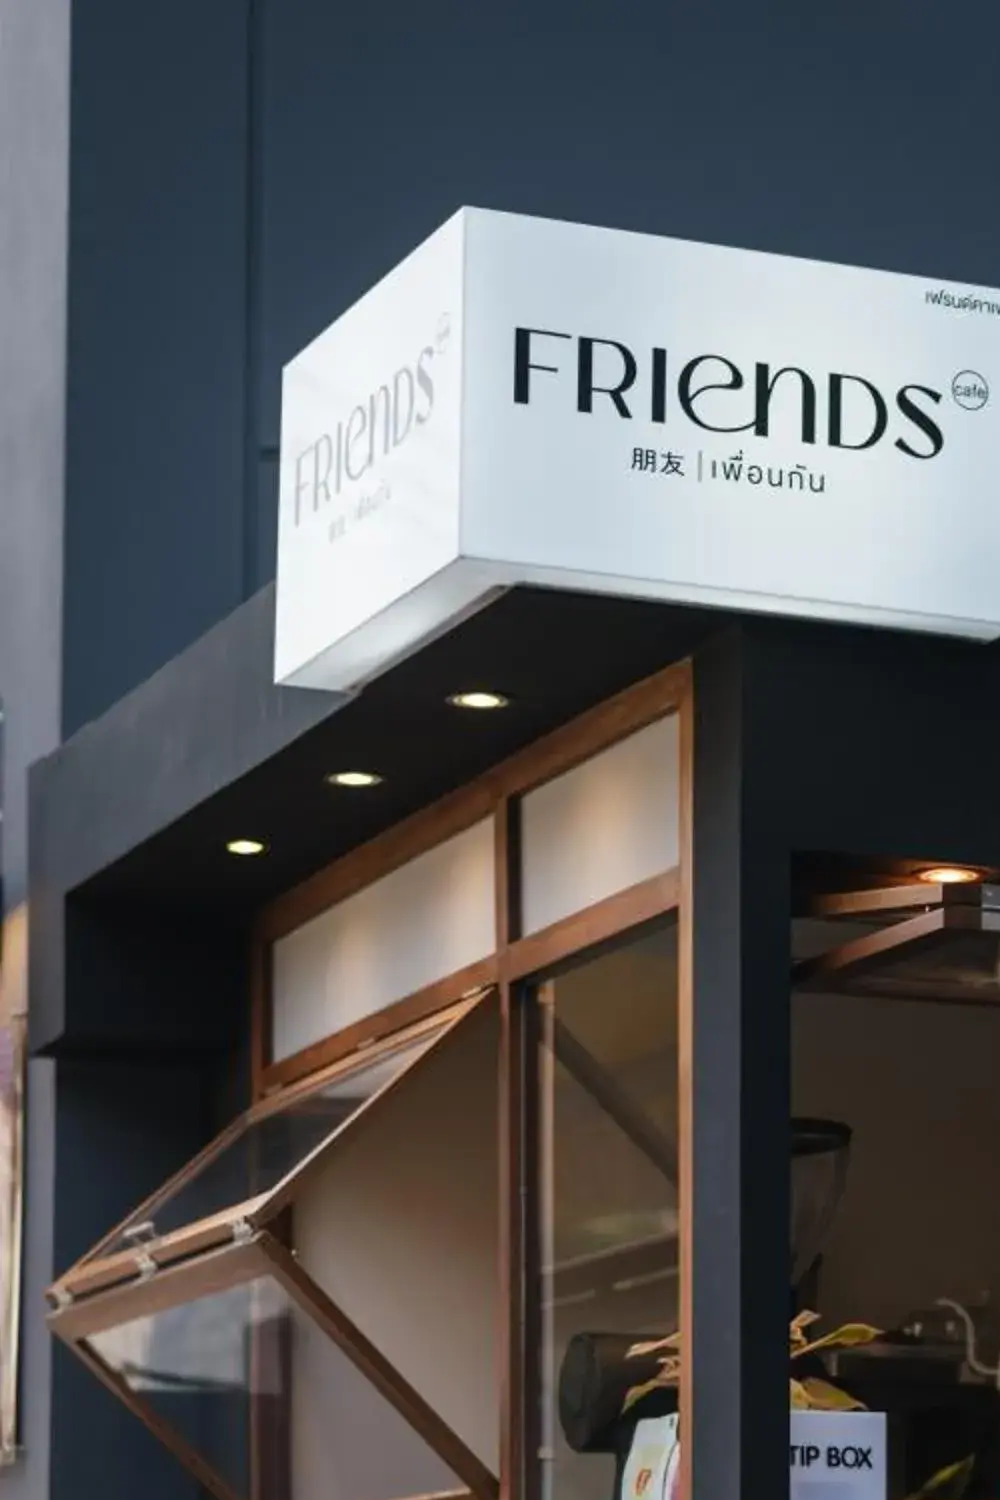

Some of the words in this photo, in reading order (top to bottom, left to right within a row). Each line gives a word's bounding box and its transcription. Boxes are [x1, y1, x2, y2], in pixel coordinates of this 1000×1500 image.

[631, 447, 685, 477] 朋友
[711, 449, 825, 493] เพื่อนกัน
[790, 1445, 820, 1467] TIP
[827, 1445, 873, 1469] BOX
